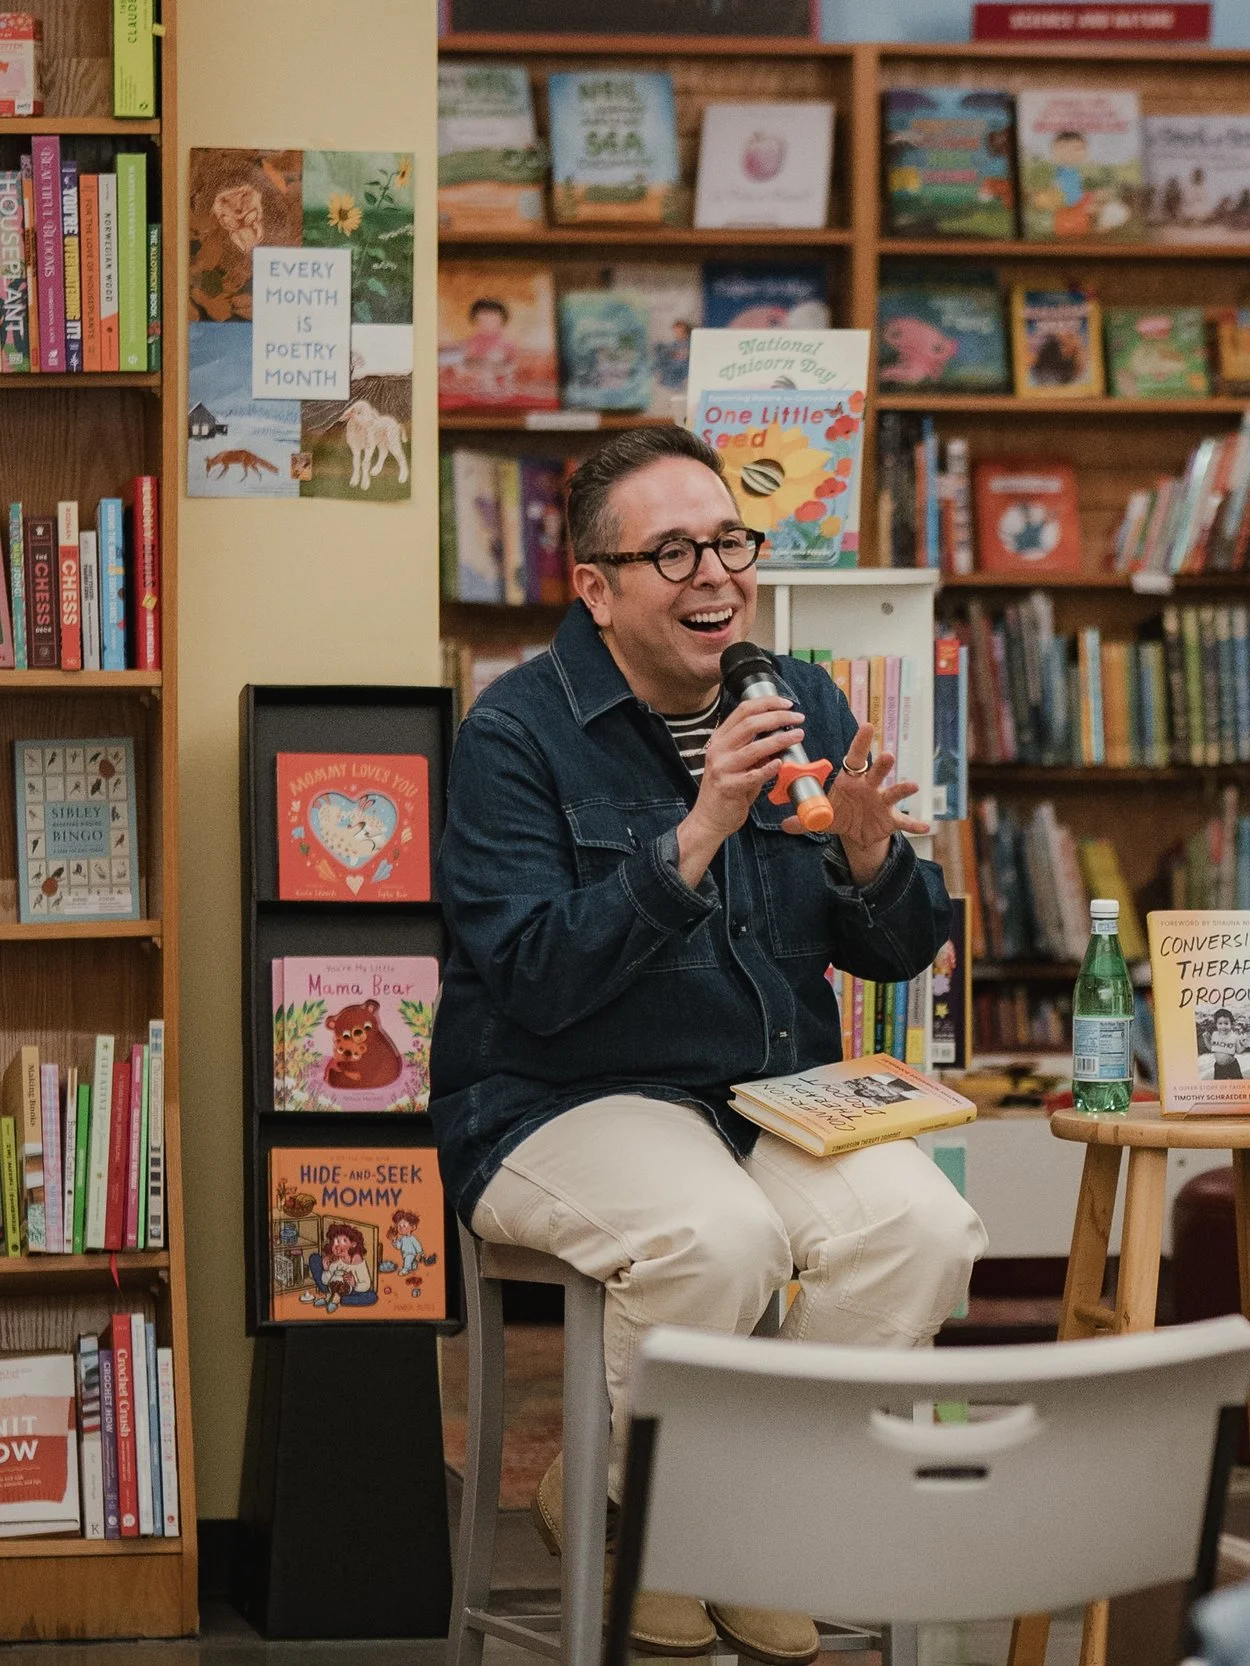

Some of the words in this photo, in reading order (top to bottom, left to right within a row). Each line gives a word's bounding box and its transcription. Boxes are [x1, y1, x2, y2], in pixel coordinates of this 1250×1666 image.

[40, 146, 55, 218] BEAUTIFUL
[63, 187, 78, 234] YOU'RE
[41, 221, 56, 278] BLOOMS
[104, 213, 112, 270] NORWEGIAN
[150, 230, 158, 245] THE
[0, 178, 25, 338] HOUSEPLANT
[87, 262, 94, 273] OF
[150, 246, 158, 292] ALLOTMENT
[270, 262, 333, 278] EVERY
[64, 236, 80, 320] OVERWATERING
[87, 276, 95, 340] HOUSEPLANTS
[150, 293, 158, 317] BOOK
[266, 288, 338, 306] MONTH
[67, 321, 81, 340] IT!
[738, 337, 823, 357] National
[265, 342, 336, 360] POETRY
[265, 368, 337, 386] MONTH
[719, 357, 795, 381] Unicorn
[799, 358, 837, 384] Day
[705, 406, 752, 424] One
[761, 406, 825, 424] Little
[702, 428, 768, 448] Seed
[34, 562, 50, 625] CHESS
[62, 560, 77, 625] CHESS
[887, 696, 895, 731] BIRDING
[903, 696, 911, 731] BIRDING
[289, 763, 347, 796] MOMMY
[352, 763, 391, 784] LOVES
[392, 775, 418, 797] YOU
[52, 807, 100, 818] SIBLEY
[53, 831, 103, 841] BINGO
[308, 974, 363, 996] Mama
[373, 974, 415, 996] Bear
[326, 964, 350, 973] You're
[355, 964, 366, 973] My
[370, 964, 395, 972] Little
[27, 1065, 36, 1098] Making
[798, 1078, 887, 1116] DROPOUT
[752, 1084, 855, 1132] CONVERSION
[783, 1083, 863, 1122] THERAPY
[66, 1120, 75, 1153] Bookish
[832, 1141, 860, 1152] CONVERSION
[860, 1136, 880, 1146] THERAPY
[880, 1131, 902, 1142] DROPOUT
[300, 1164, 423, 1185] HIDE-AND-SEEK
[321, 1186, 403, 1208] MOMMY
[103, 1362, 112, 1407] CROCHET
[116, 1348, 129, 1397] Crochet
[105, 1409, 113, 1433] HOW
[118, 1399, 131, 1437] Crush
